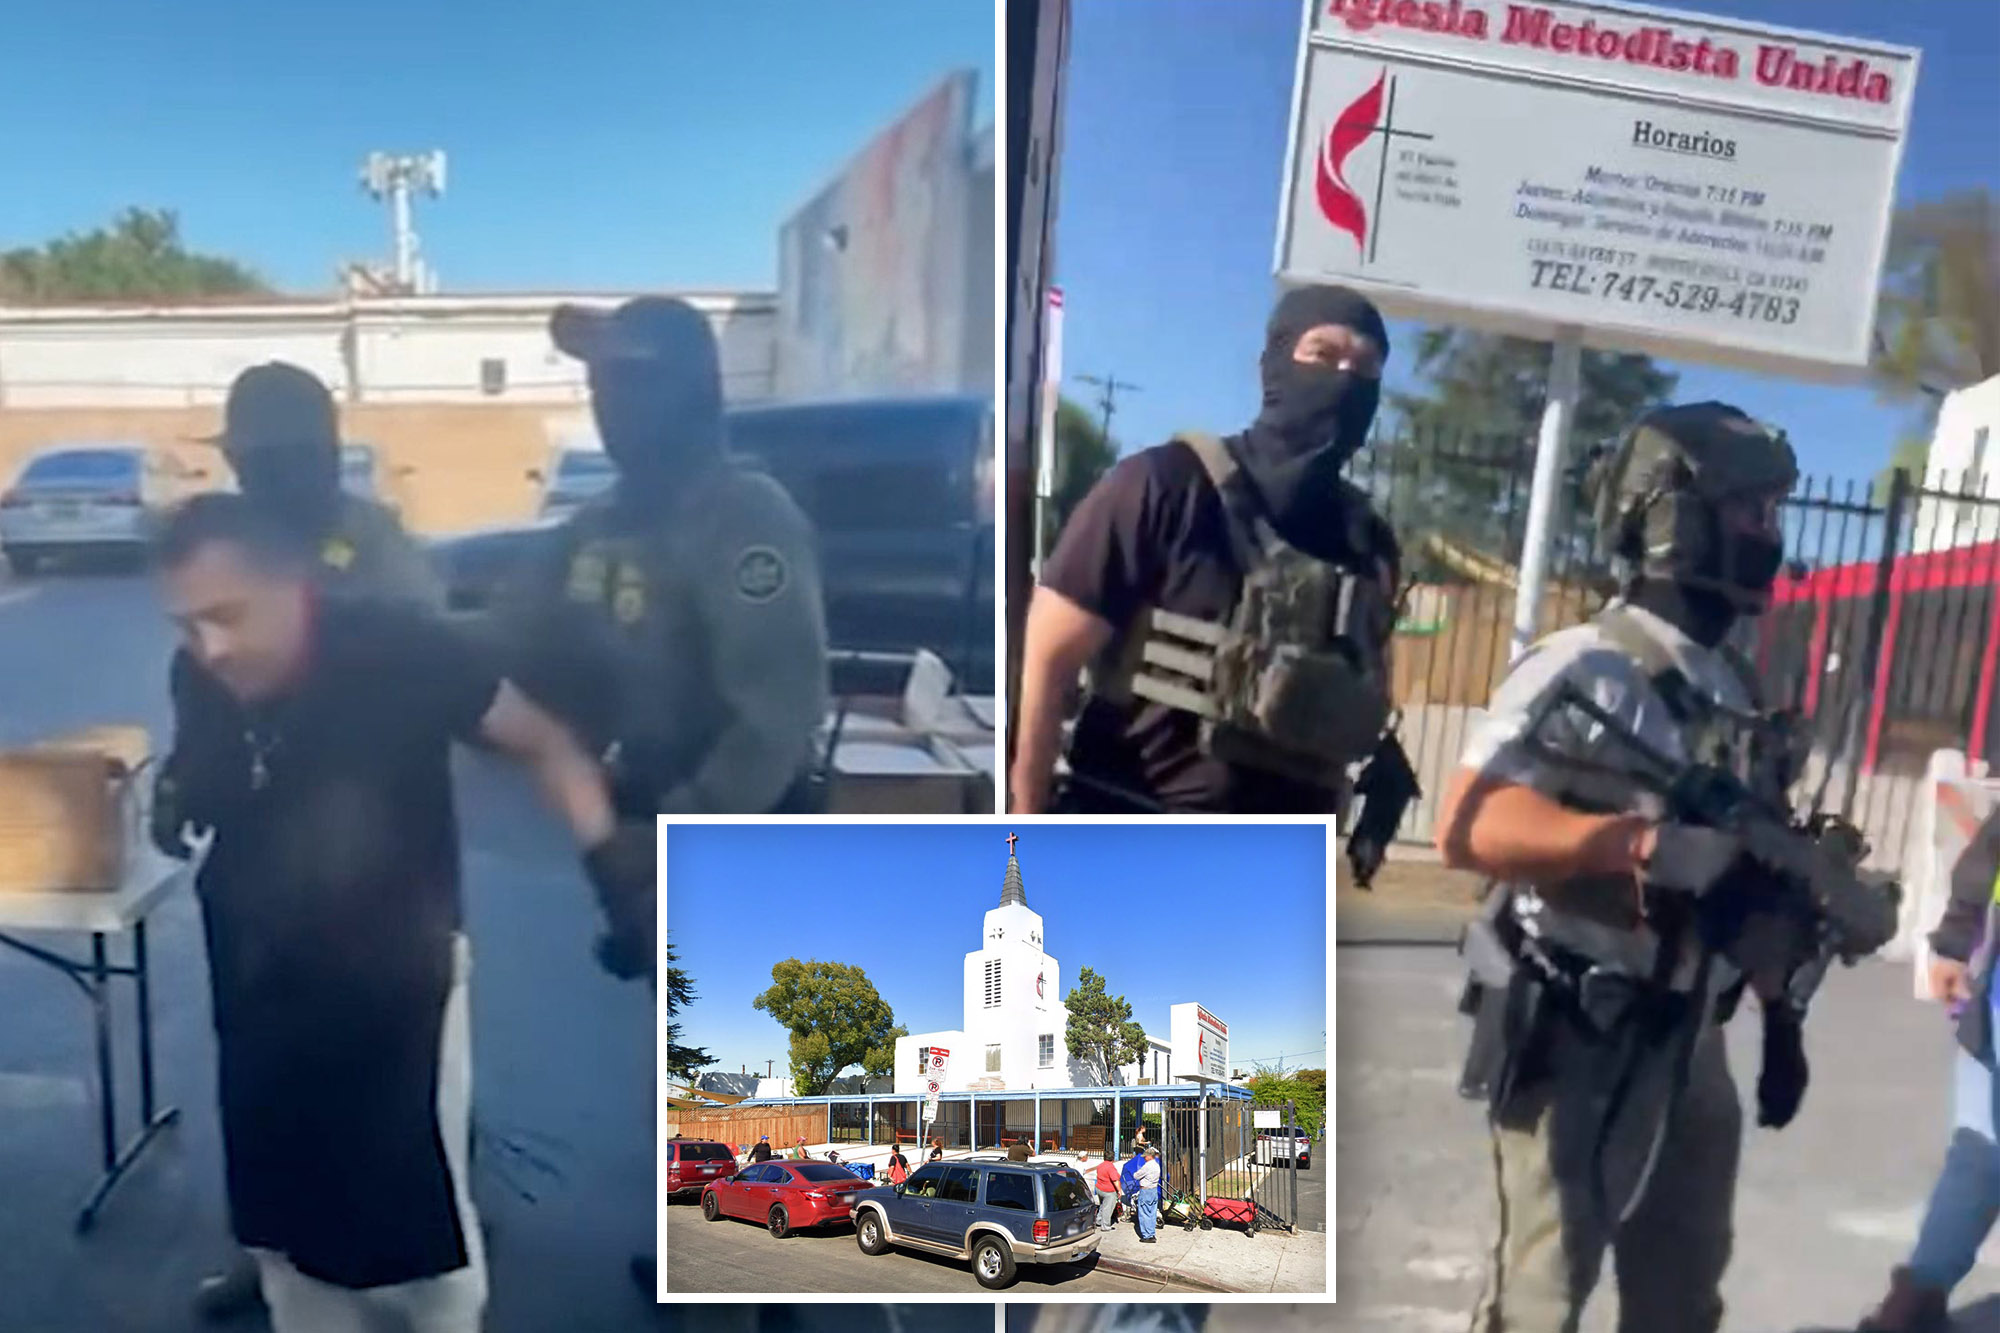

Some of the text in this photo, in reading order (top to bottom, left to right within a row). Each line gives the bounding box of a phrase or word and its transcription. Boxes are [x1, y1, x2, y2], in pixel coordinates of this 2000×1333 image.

[1501, 5, 1739, 79] Metodista
[1756, 45, 1891, 102] Unida
[1634, 121, 1736, 157] Horarios
[1603, 271, 1800, 324] 747-529-4783
